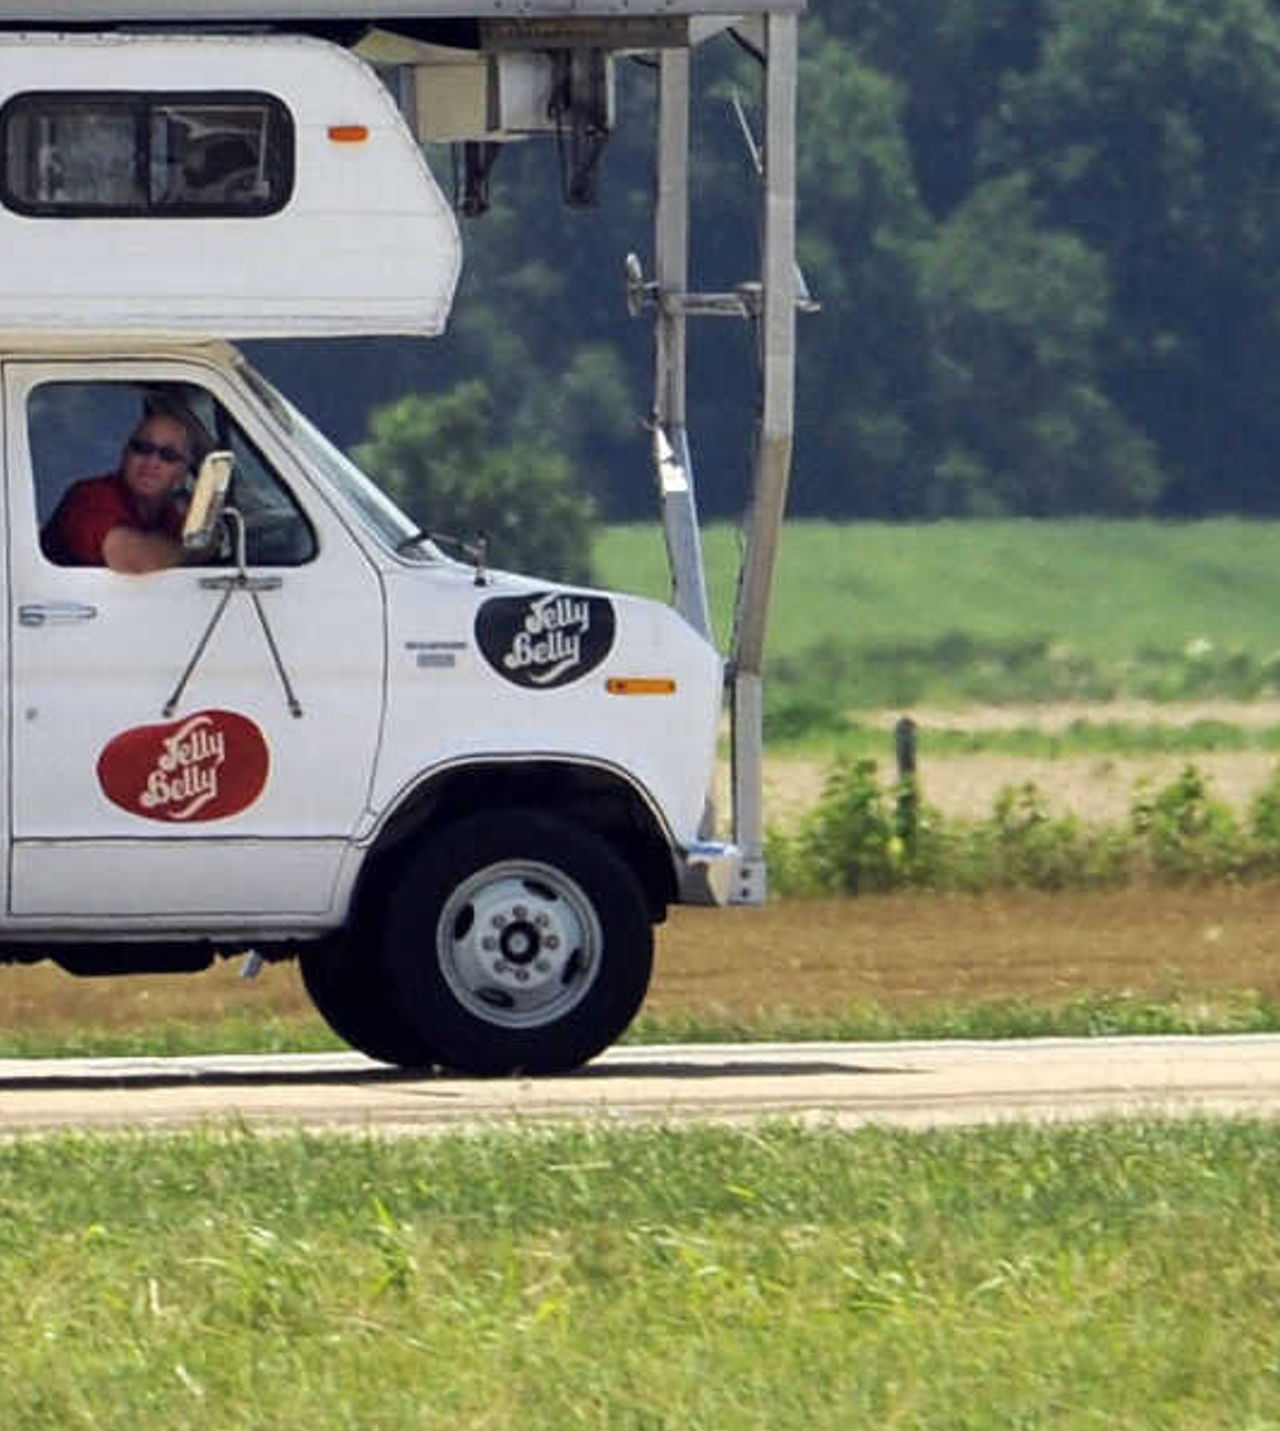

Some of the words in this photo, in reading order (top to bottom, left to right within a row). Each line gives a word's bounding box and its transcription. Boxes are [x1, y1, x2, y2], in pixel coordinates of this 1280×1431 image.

[524, 591, 590, 634] Jelly
[503, 632, 581, 684] Belly
[159, 716, 225, 771] Jelly
[140, 763, 218, 819] Belly
